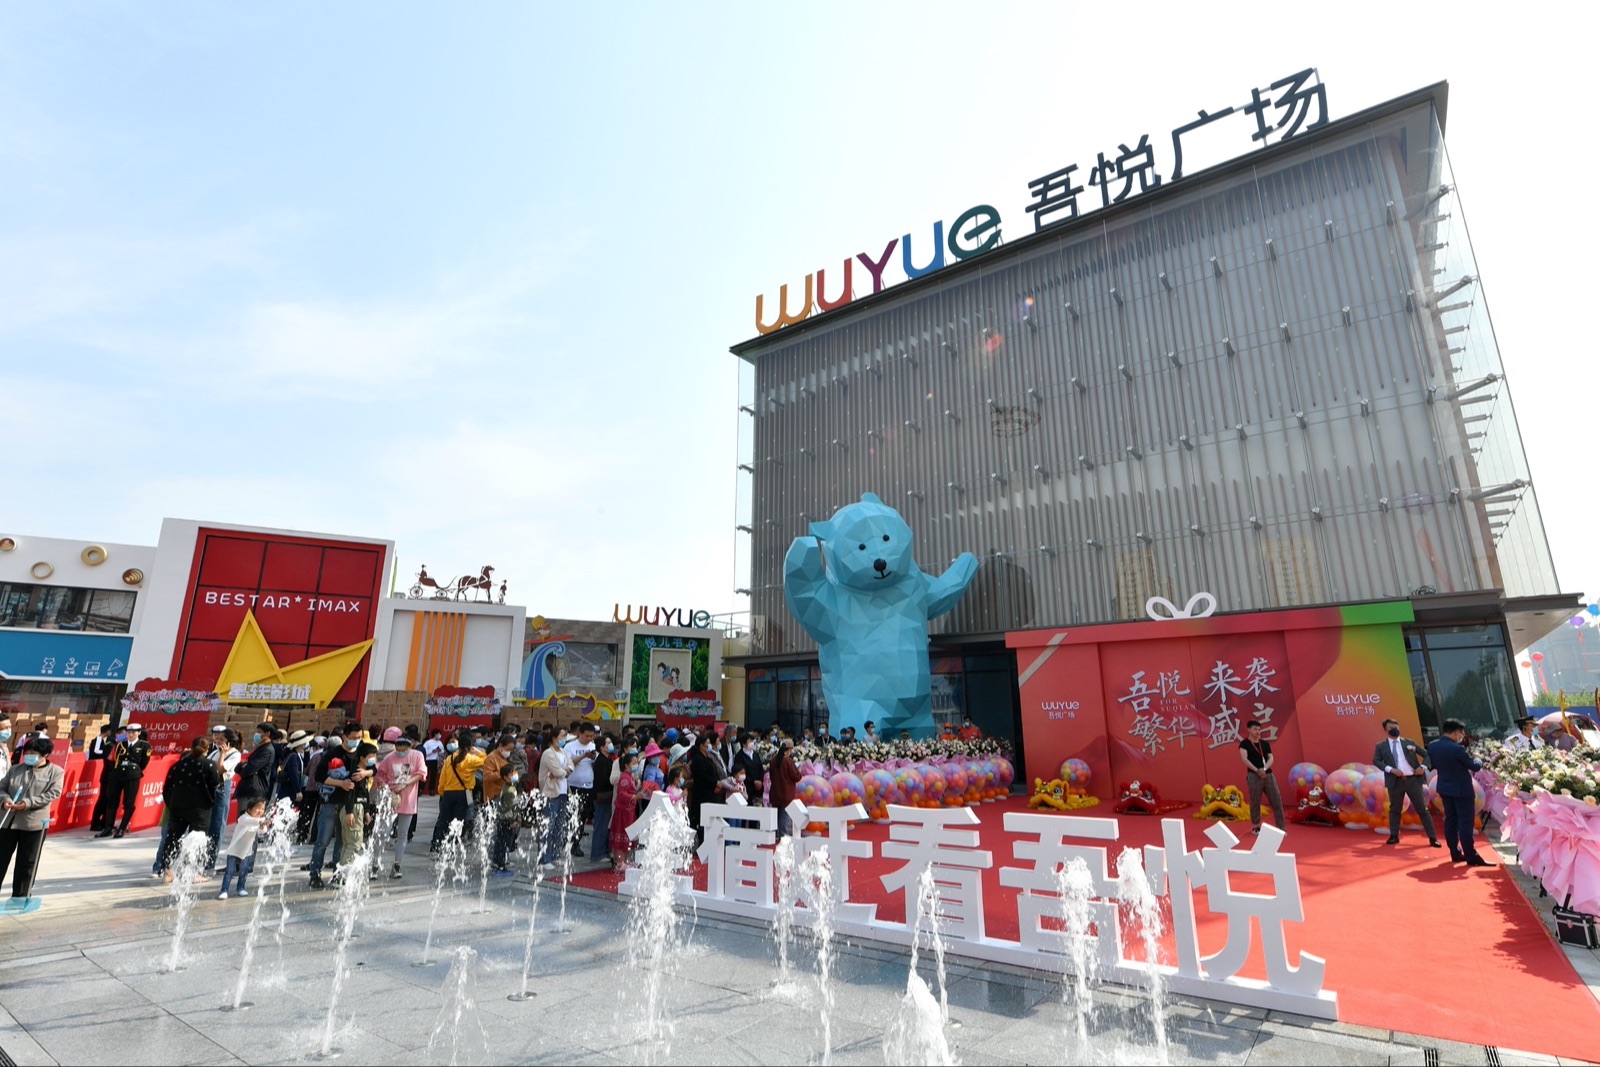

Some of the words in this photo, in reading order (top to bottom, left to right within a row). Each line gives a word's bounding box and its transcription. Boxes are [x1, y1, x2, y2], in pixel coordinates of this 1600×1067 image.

[1025, 67, 1329, 232] 吾悦广场
[307, 598, 360, 613] IMAX
[1159, 698, 1178, 706] FOR
[1160, 704, 1197, 712] SUQIAN
[1336, 705, 1375, 716] 吾悦广场
